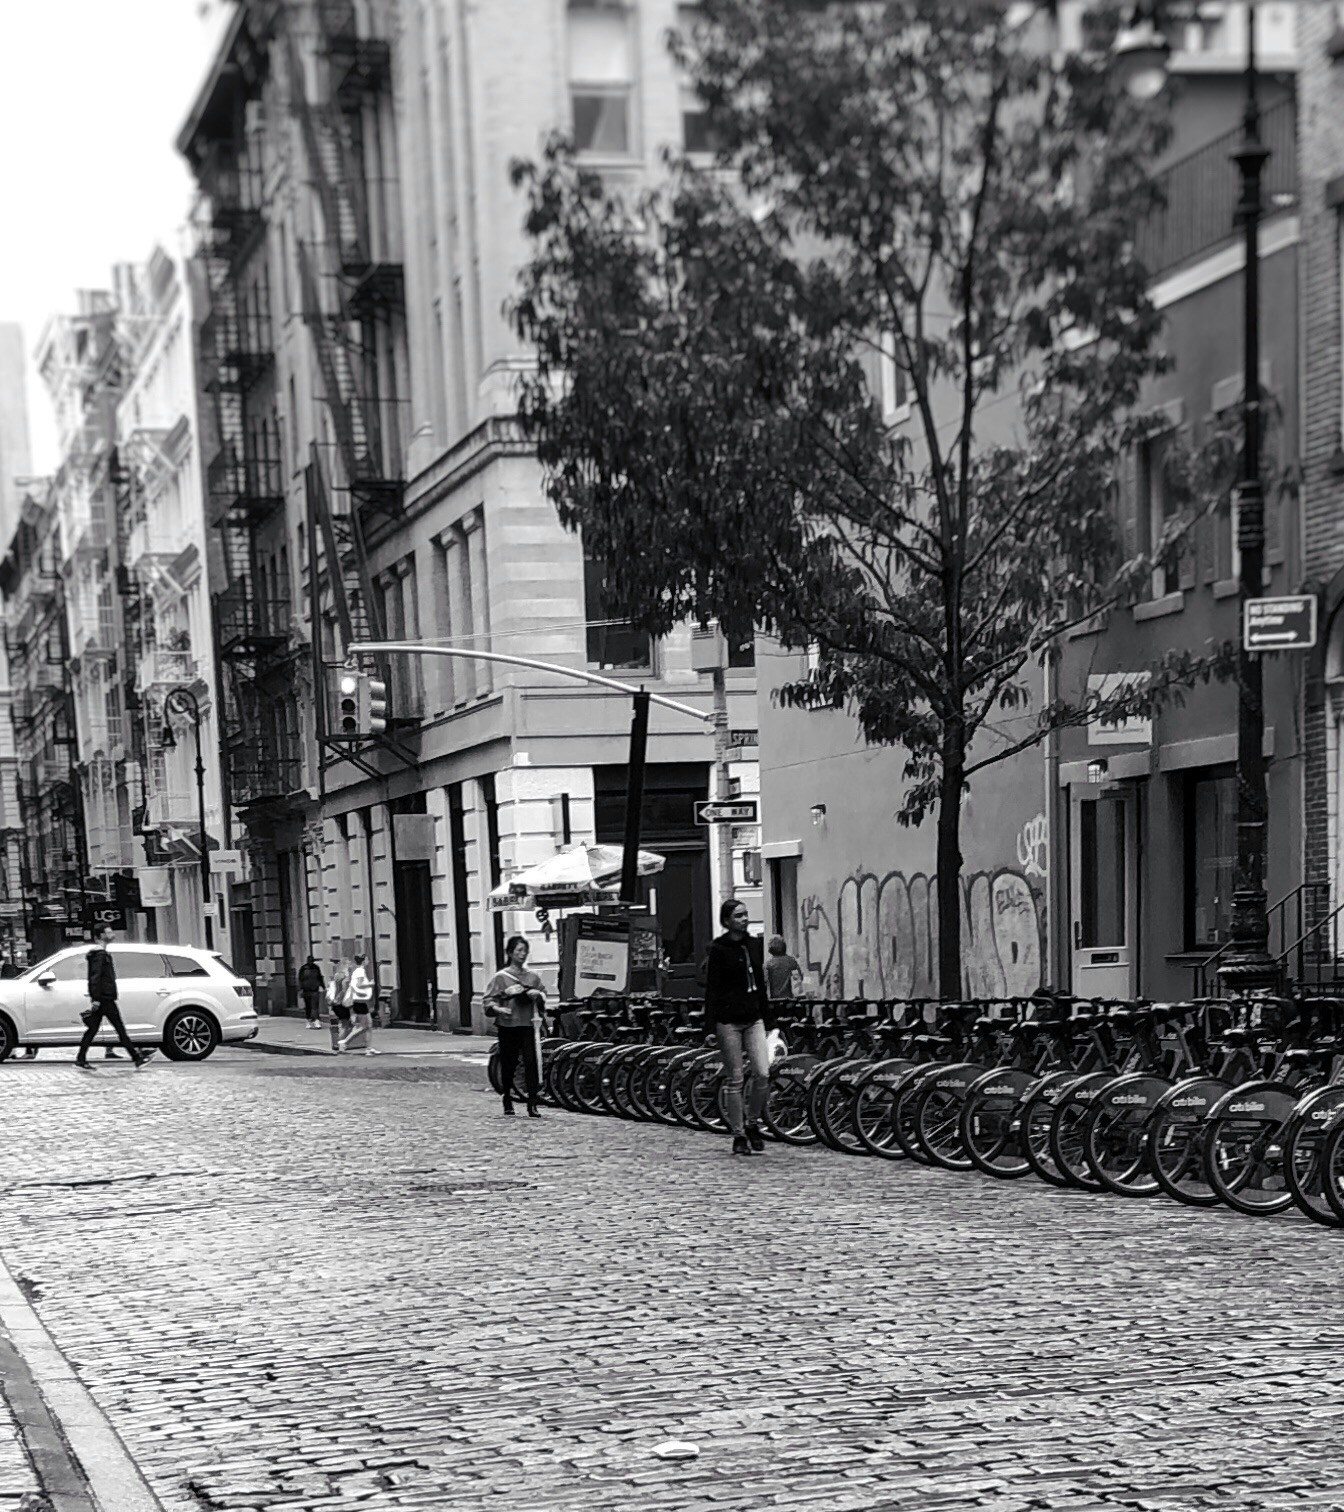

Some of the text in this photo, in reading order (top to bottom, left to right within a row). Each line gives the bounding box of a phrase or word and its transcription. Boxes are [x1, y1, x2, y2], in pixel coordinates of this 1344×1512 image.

[1249, 602, 1304, 615] NO STANDING
[706, 808, 749, 817] ONE WAY
[93, 909, 121, 922] UGG
